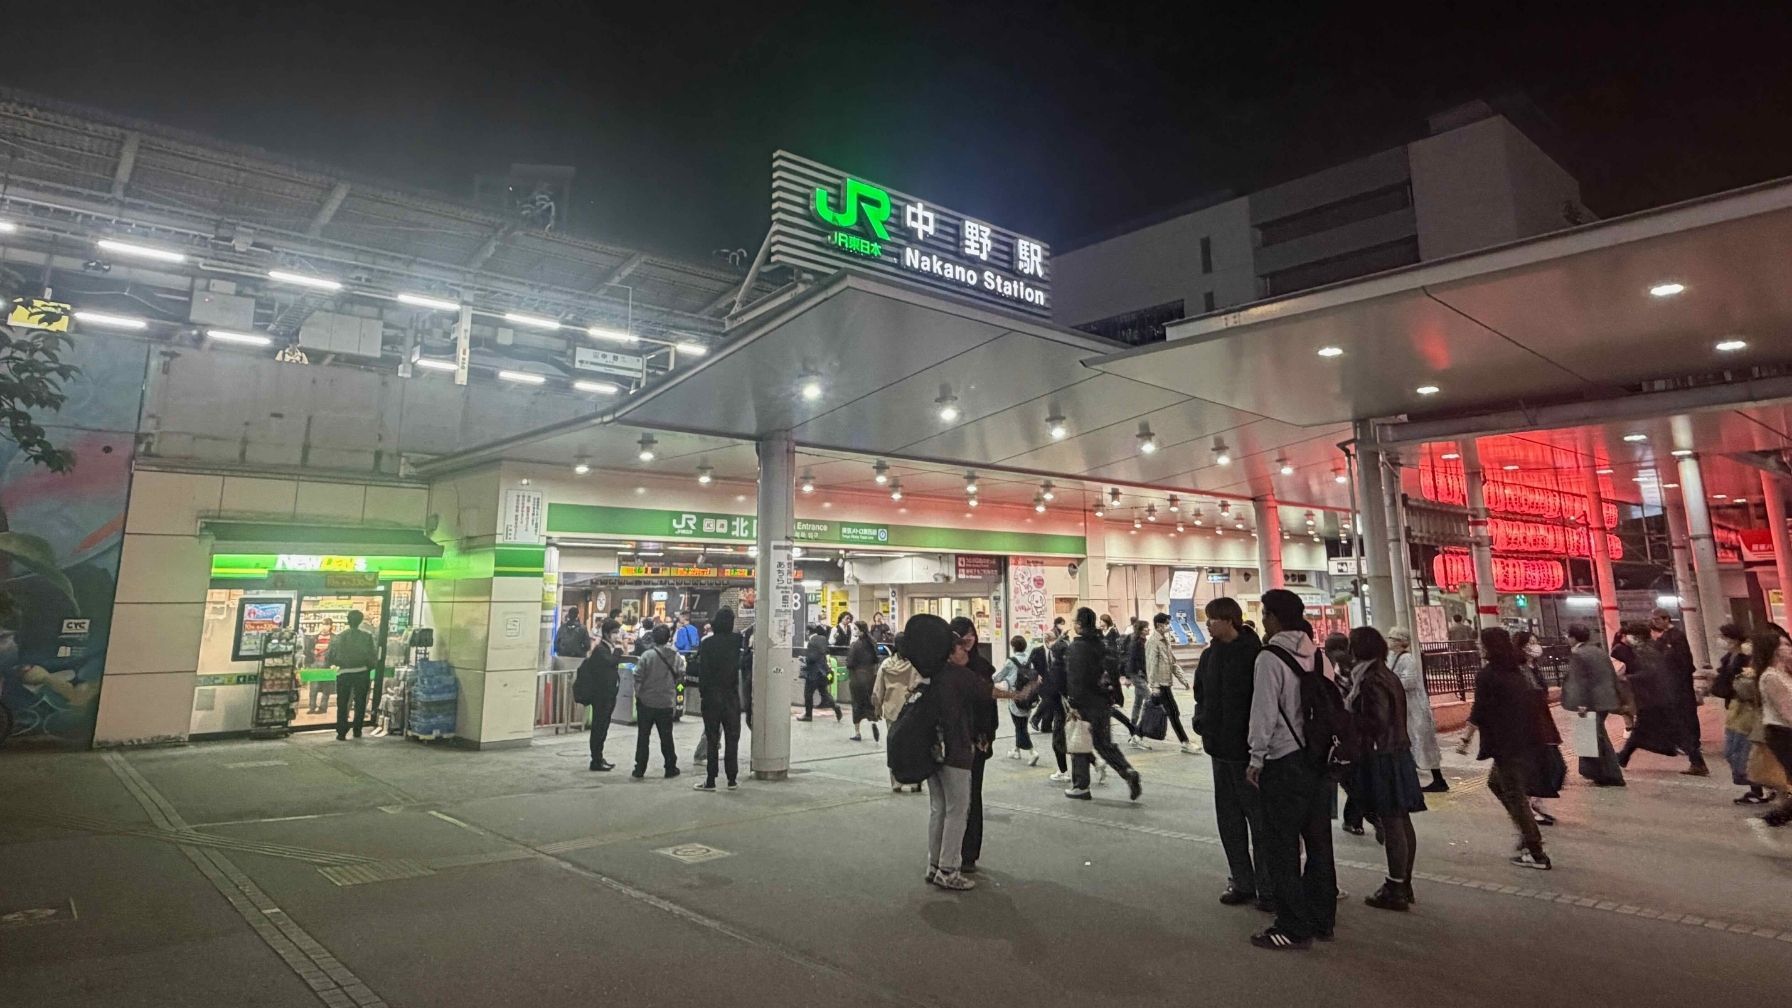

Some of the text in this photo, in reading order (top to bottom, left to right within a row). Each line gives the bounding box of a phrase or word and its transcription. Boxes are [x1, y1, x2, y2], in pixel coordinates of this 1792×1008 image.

[815, 177, 891, 241] JR
[833, 231, 882, 257] JR東日本
[906, 202, 1044, 278] 中野駅
[905, 247, 1045, 306] Nakano Station
[672, 514, 697, 530] JR
[797, 522, 828, 531] Entrance
[776, 561, 785, 585] あちら
